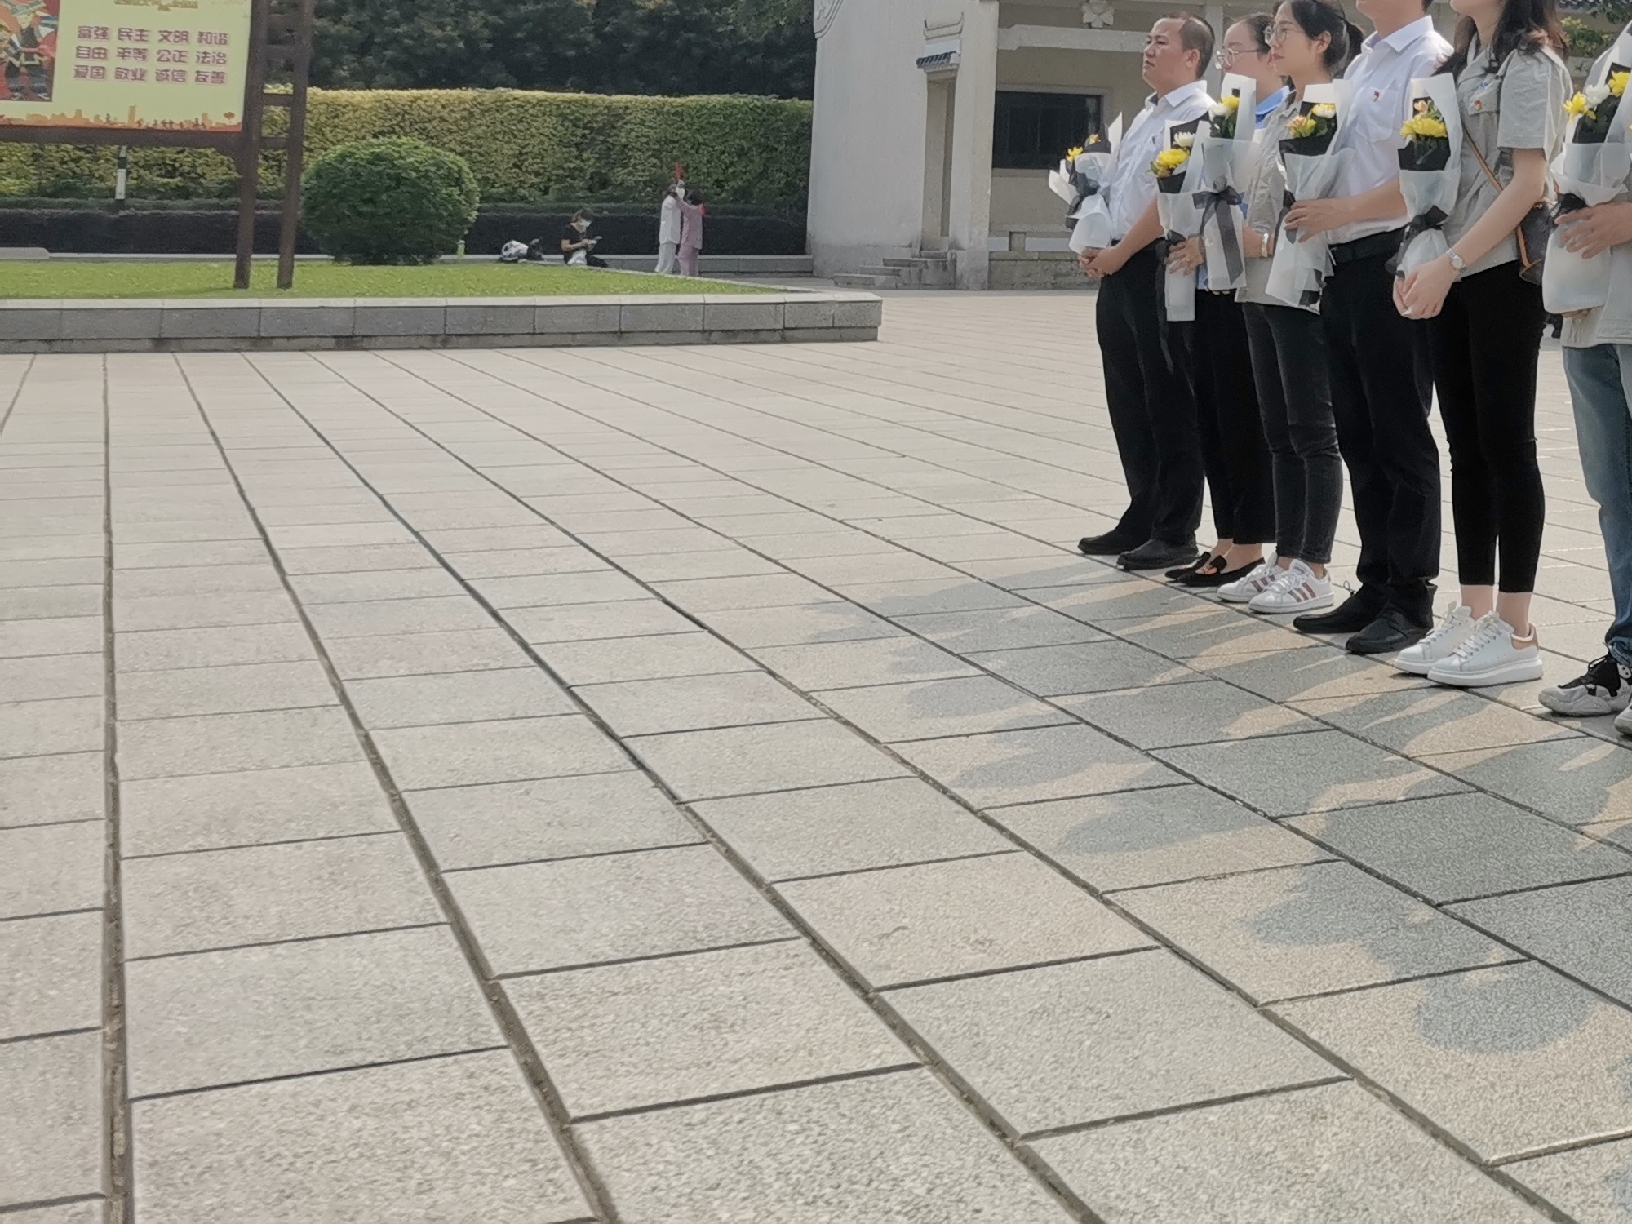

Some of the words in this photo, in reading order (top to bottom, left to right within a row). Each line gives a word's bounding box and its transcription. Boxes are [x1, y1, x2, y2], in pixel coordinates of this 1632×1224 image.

[117, 27, 150, 43] 民主
[157, 29, 189, 44] 文明
[196, 31, 229, 46] 和谐
[75, 46, 108, 60] 自由
[116, 47, 149, 62] 平等
[156, 49, 189, 64] 公正
[196, 50, 227, 65] 法治
[115, 67, 147, 82] 敬业
[155, 69, 188, 83] 诚信
[195, 70, 226, 84] 友善
